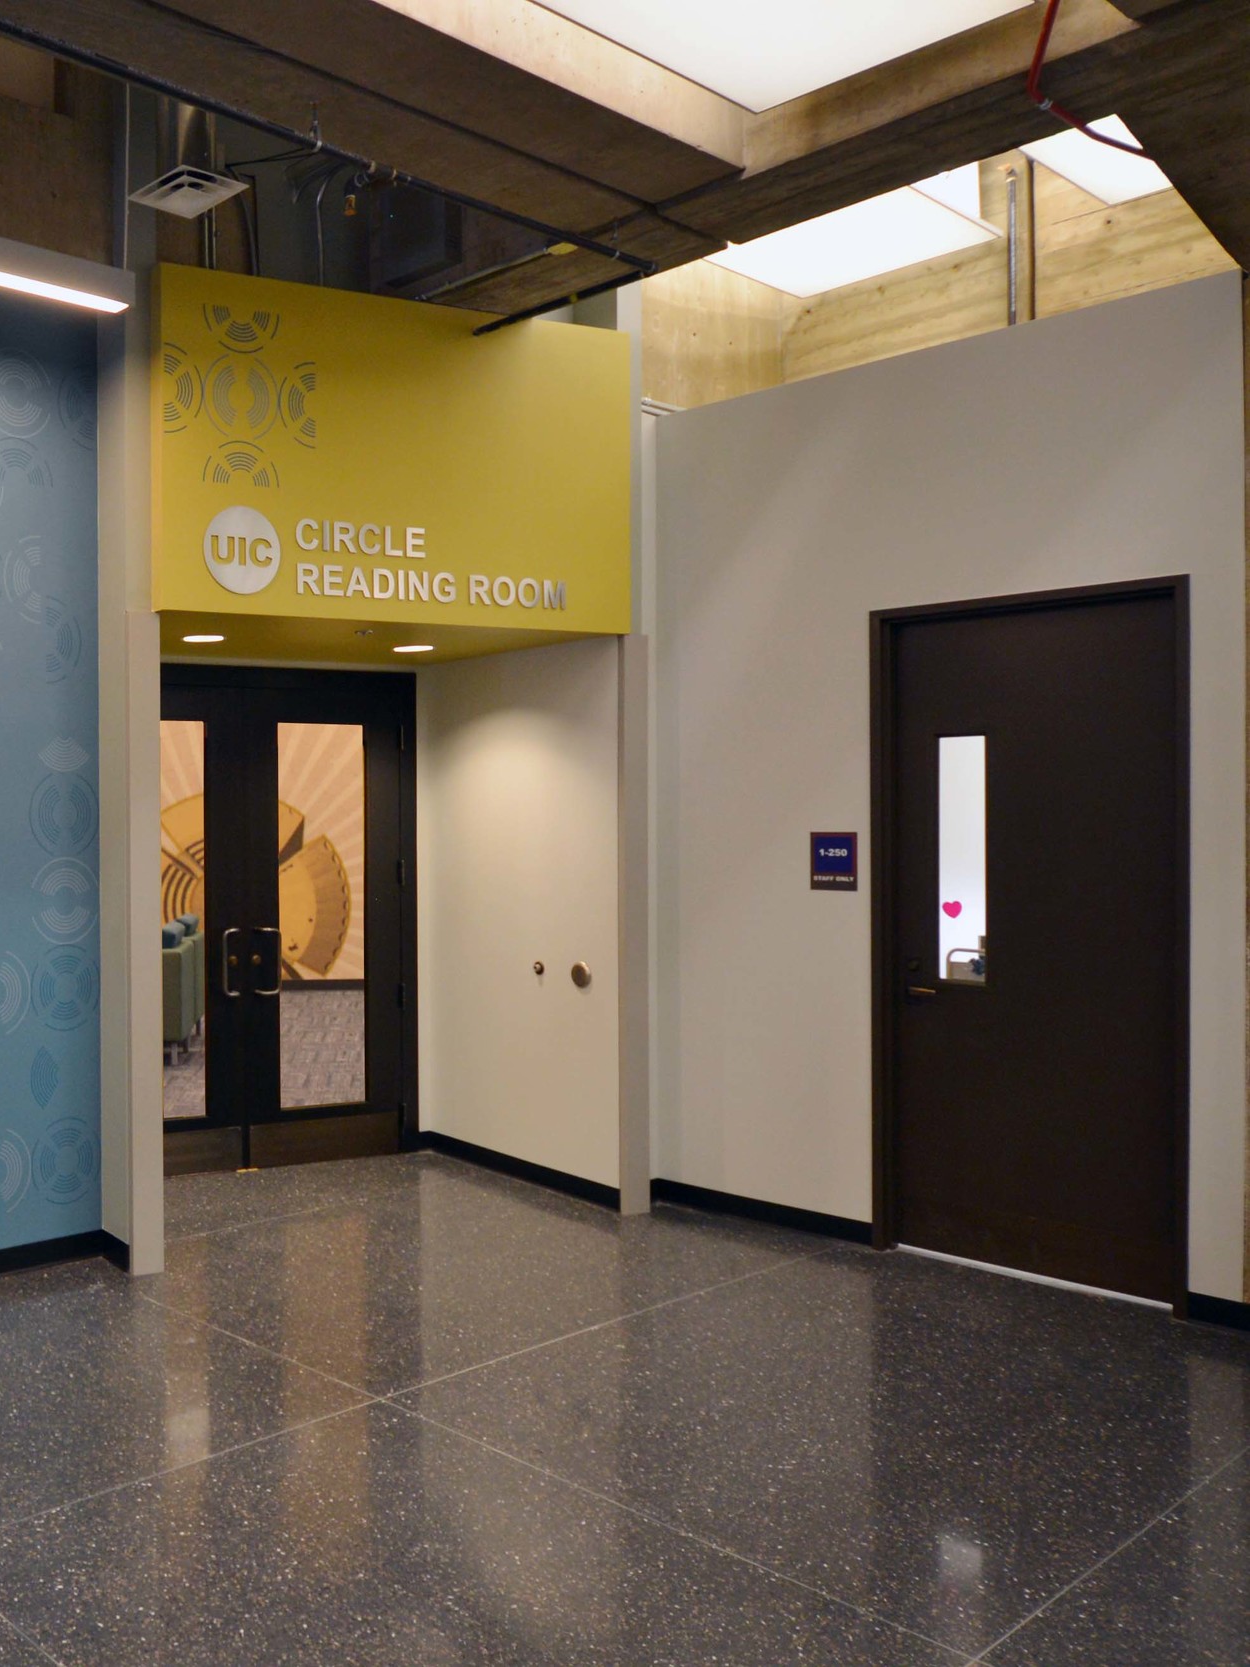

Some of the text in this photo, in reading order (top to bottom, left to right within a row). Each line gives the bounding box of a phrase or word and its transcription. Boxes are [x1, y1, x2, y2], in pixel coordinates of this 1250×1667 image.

[210, 534, 274, 567] UIC
[295, 518, 426, 559] CIRCLE
[296, 563, 566, 610] READING ROOM
[819, 848, 848, 857] 1-250
